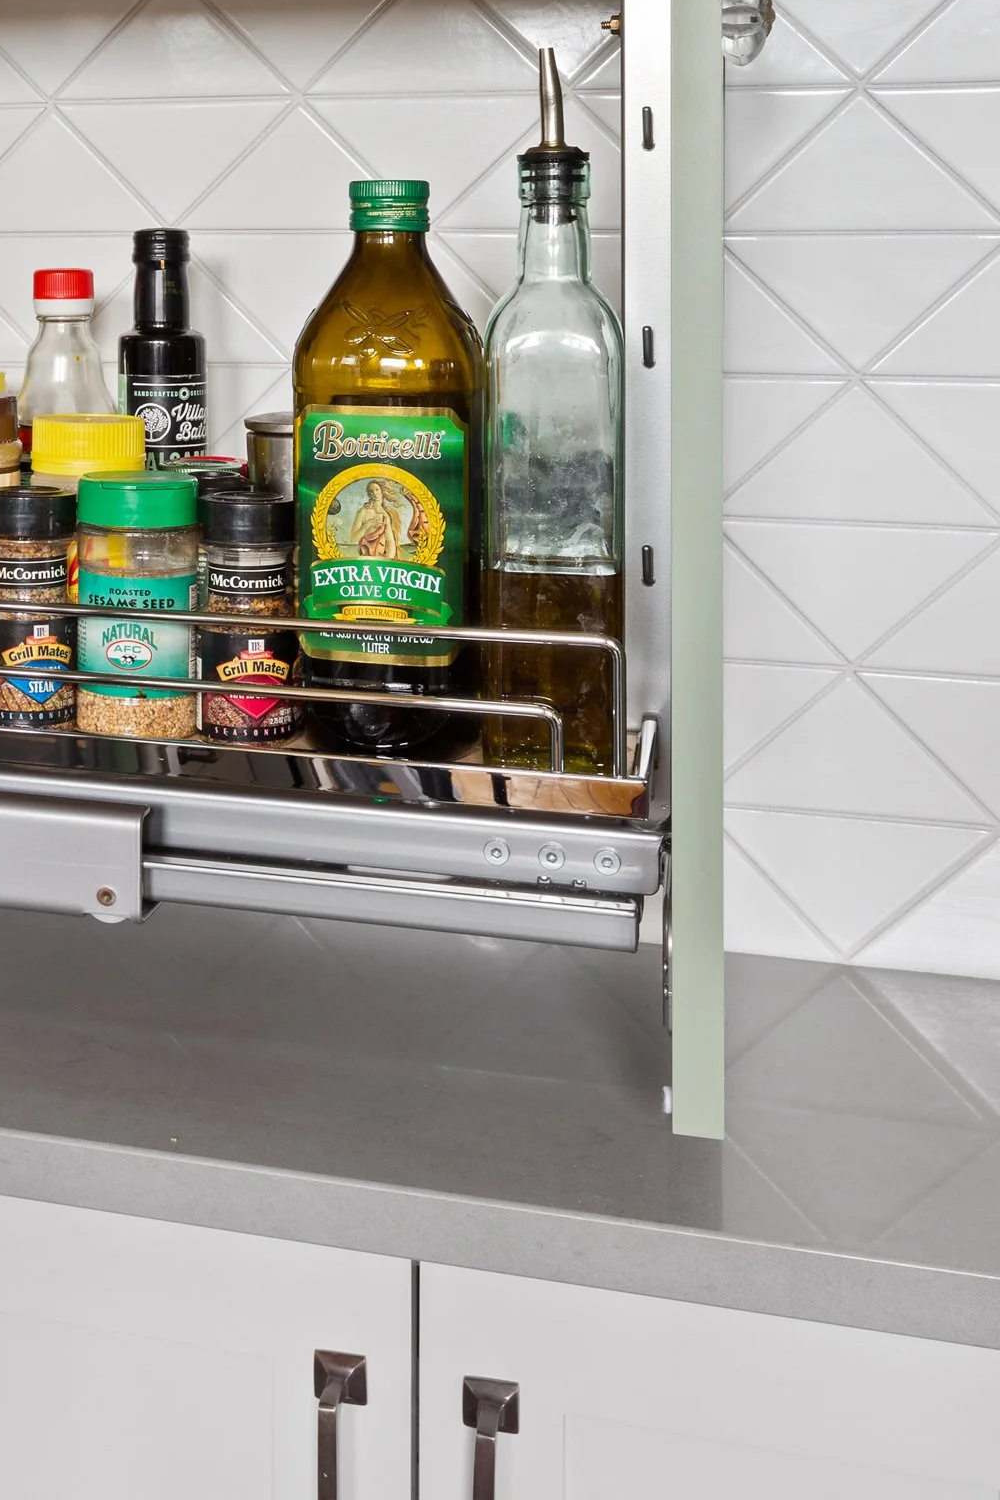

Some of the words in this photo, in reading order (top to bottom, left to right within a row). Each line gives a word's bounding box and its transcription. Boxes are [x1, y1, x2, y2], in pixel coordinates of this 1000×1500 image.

[312, 419, 442, 462] Botticelli
[210, 572, 284, 589] McCormick
[313, 565, 374, 587] EXTRA
[376, 566, 442, 594] VIRGIN
[109, 588, 151, 596] ROASTED
[340, 584, 383, 598] OLIVE
[386, 586, 412, 602] OIL
[88, 594, 137, 608] SESAME
[142, 598, 175, 609] SEED
[343, 607, 364, 617] COLD
[364, 606, 407, 619] EXTRACTED
[102, 622, 158, 650] NATURAL
[8, 646, 34, 662] Grill
[38, 645, 69, 659] Mates
[113, 644, 142, 654] AFC
[361, 642, 366, 652] 1
[367, 642, 390, 654] LITER
[222, 661, 248, 677] Grill
[252, 661, 286, 676] Mates
[28, 680, 55, 694] STEAK
